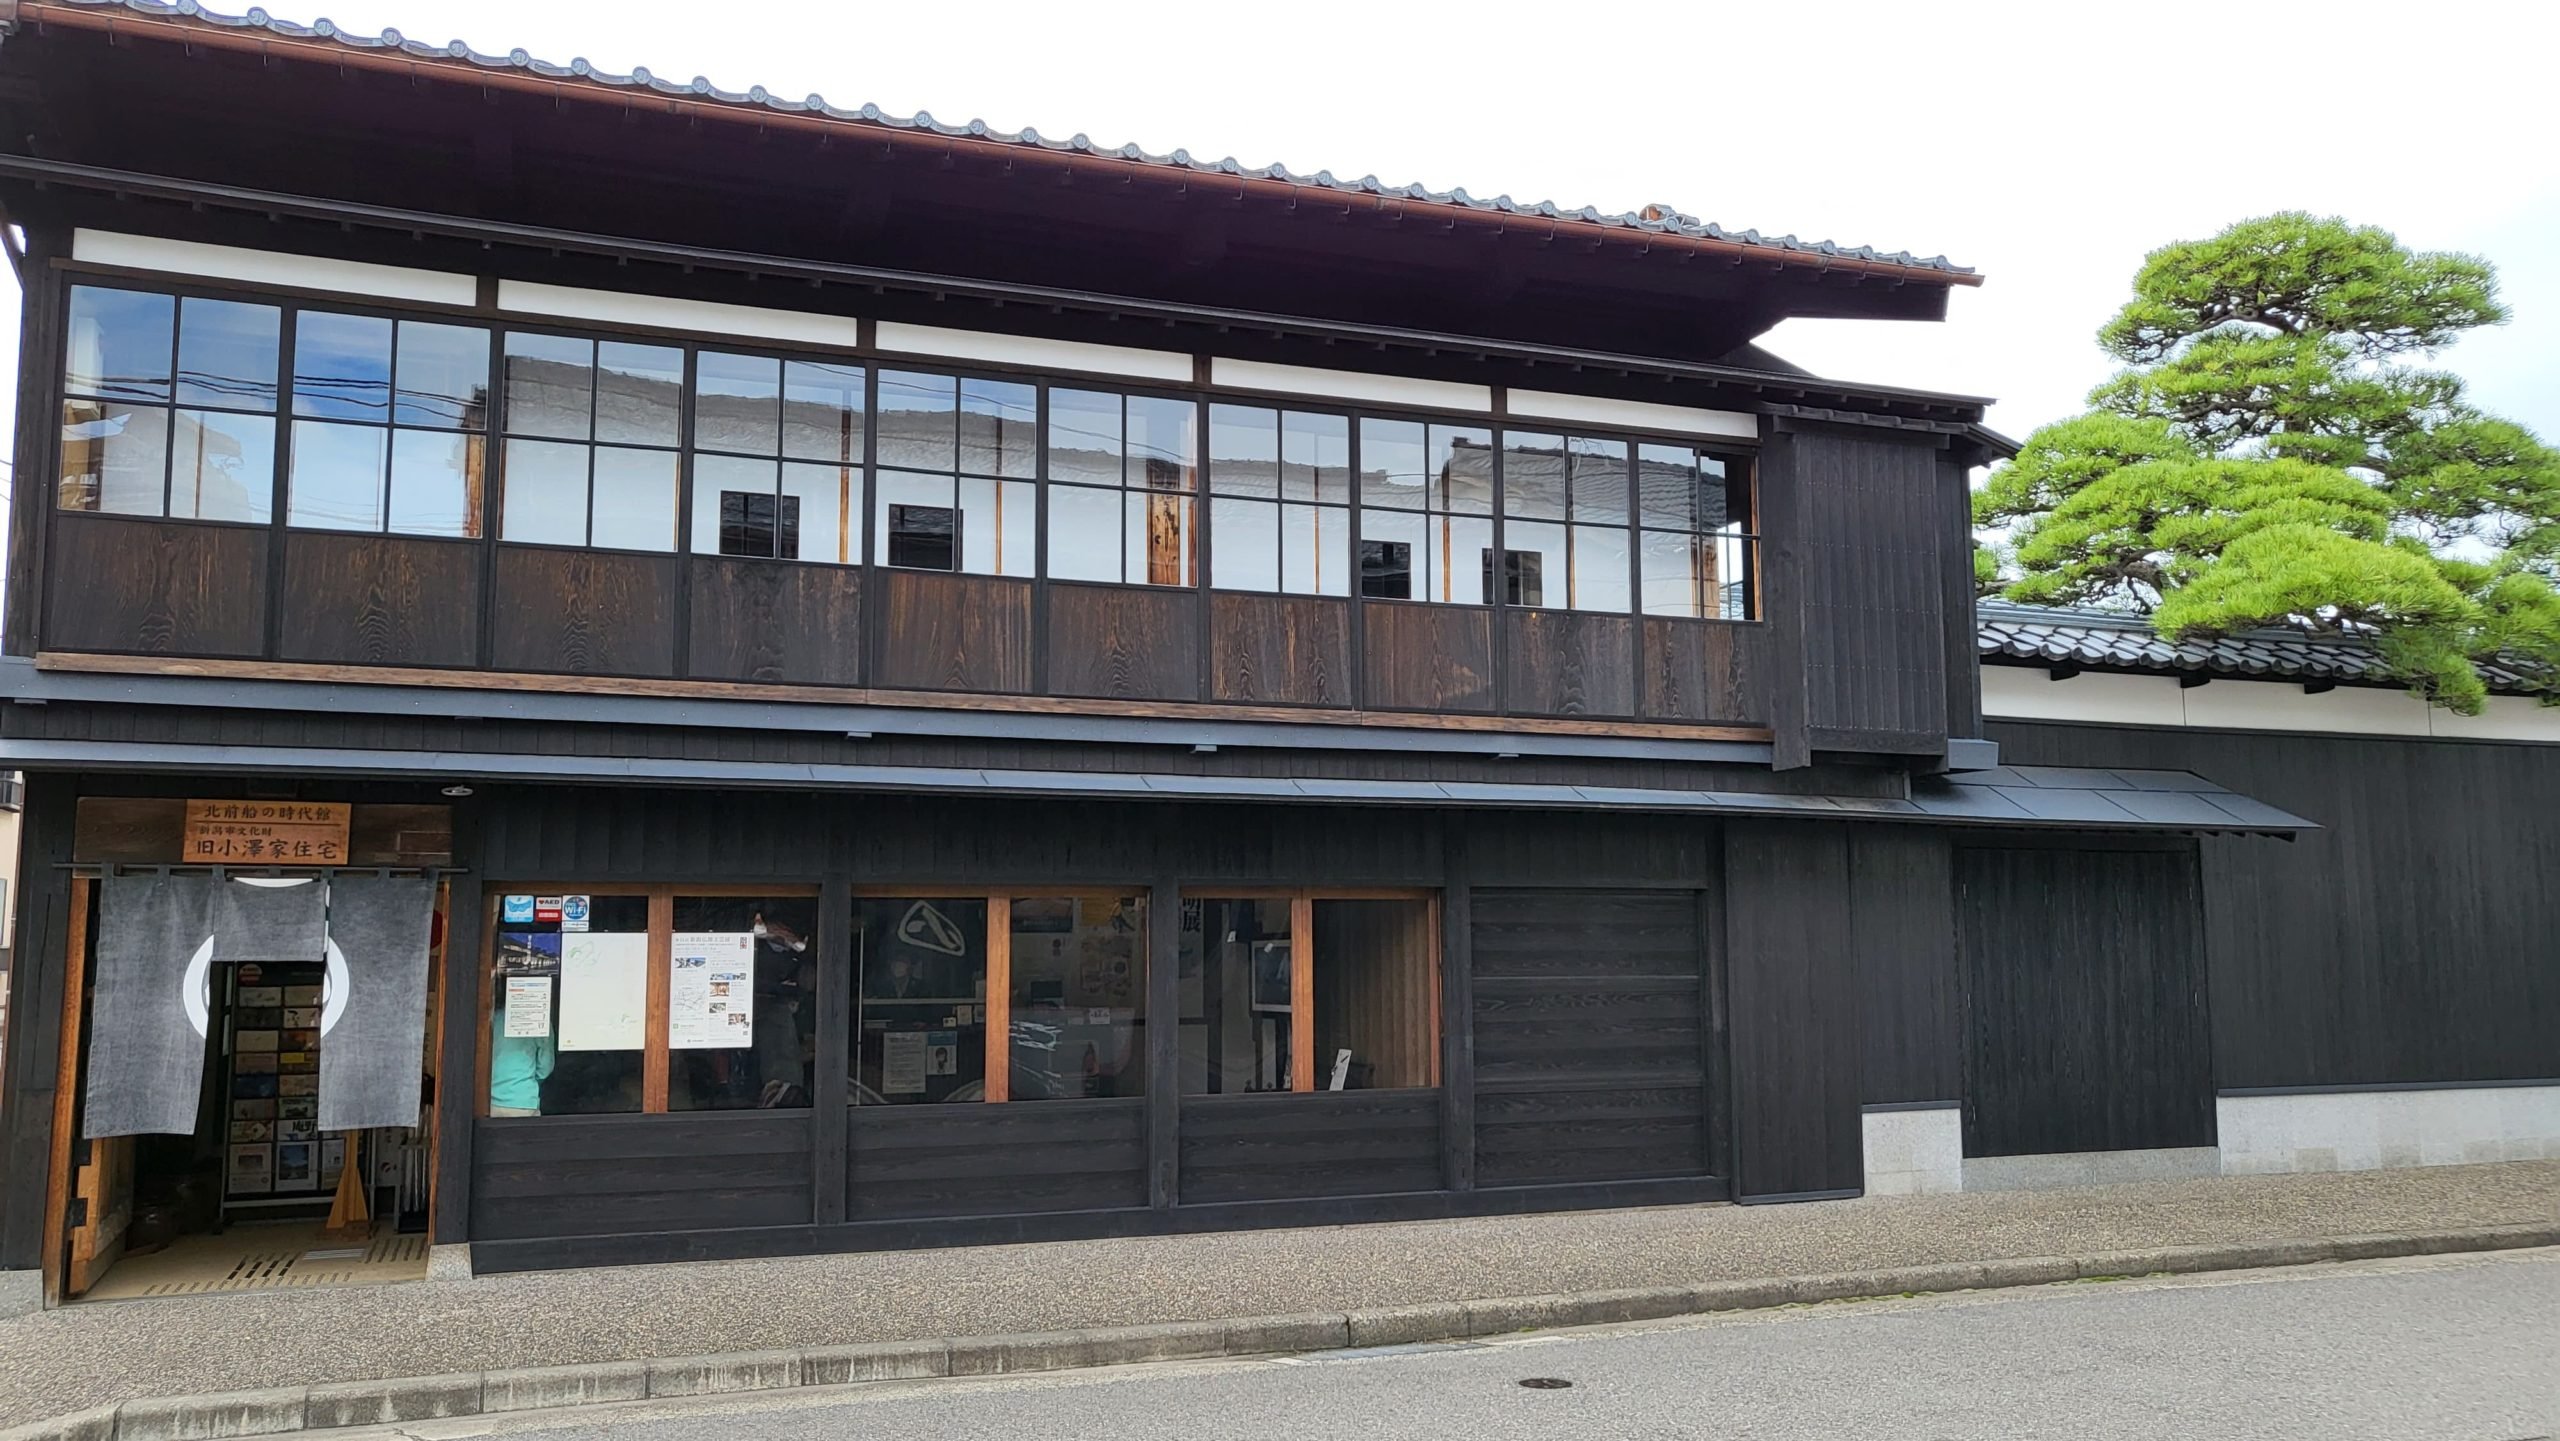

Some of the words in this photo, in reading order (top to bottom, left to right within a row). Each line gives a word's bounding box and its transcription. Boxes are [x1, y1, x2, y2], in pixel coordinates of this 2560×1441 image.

[204, 804, 332, 821] 北前船の時代館
[196, 838, 337, 860] 旧小澤家住宅
[565, 906, 586, 914] Wi-Fi
